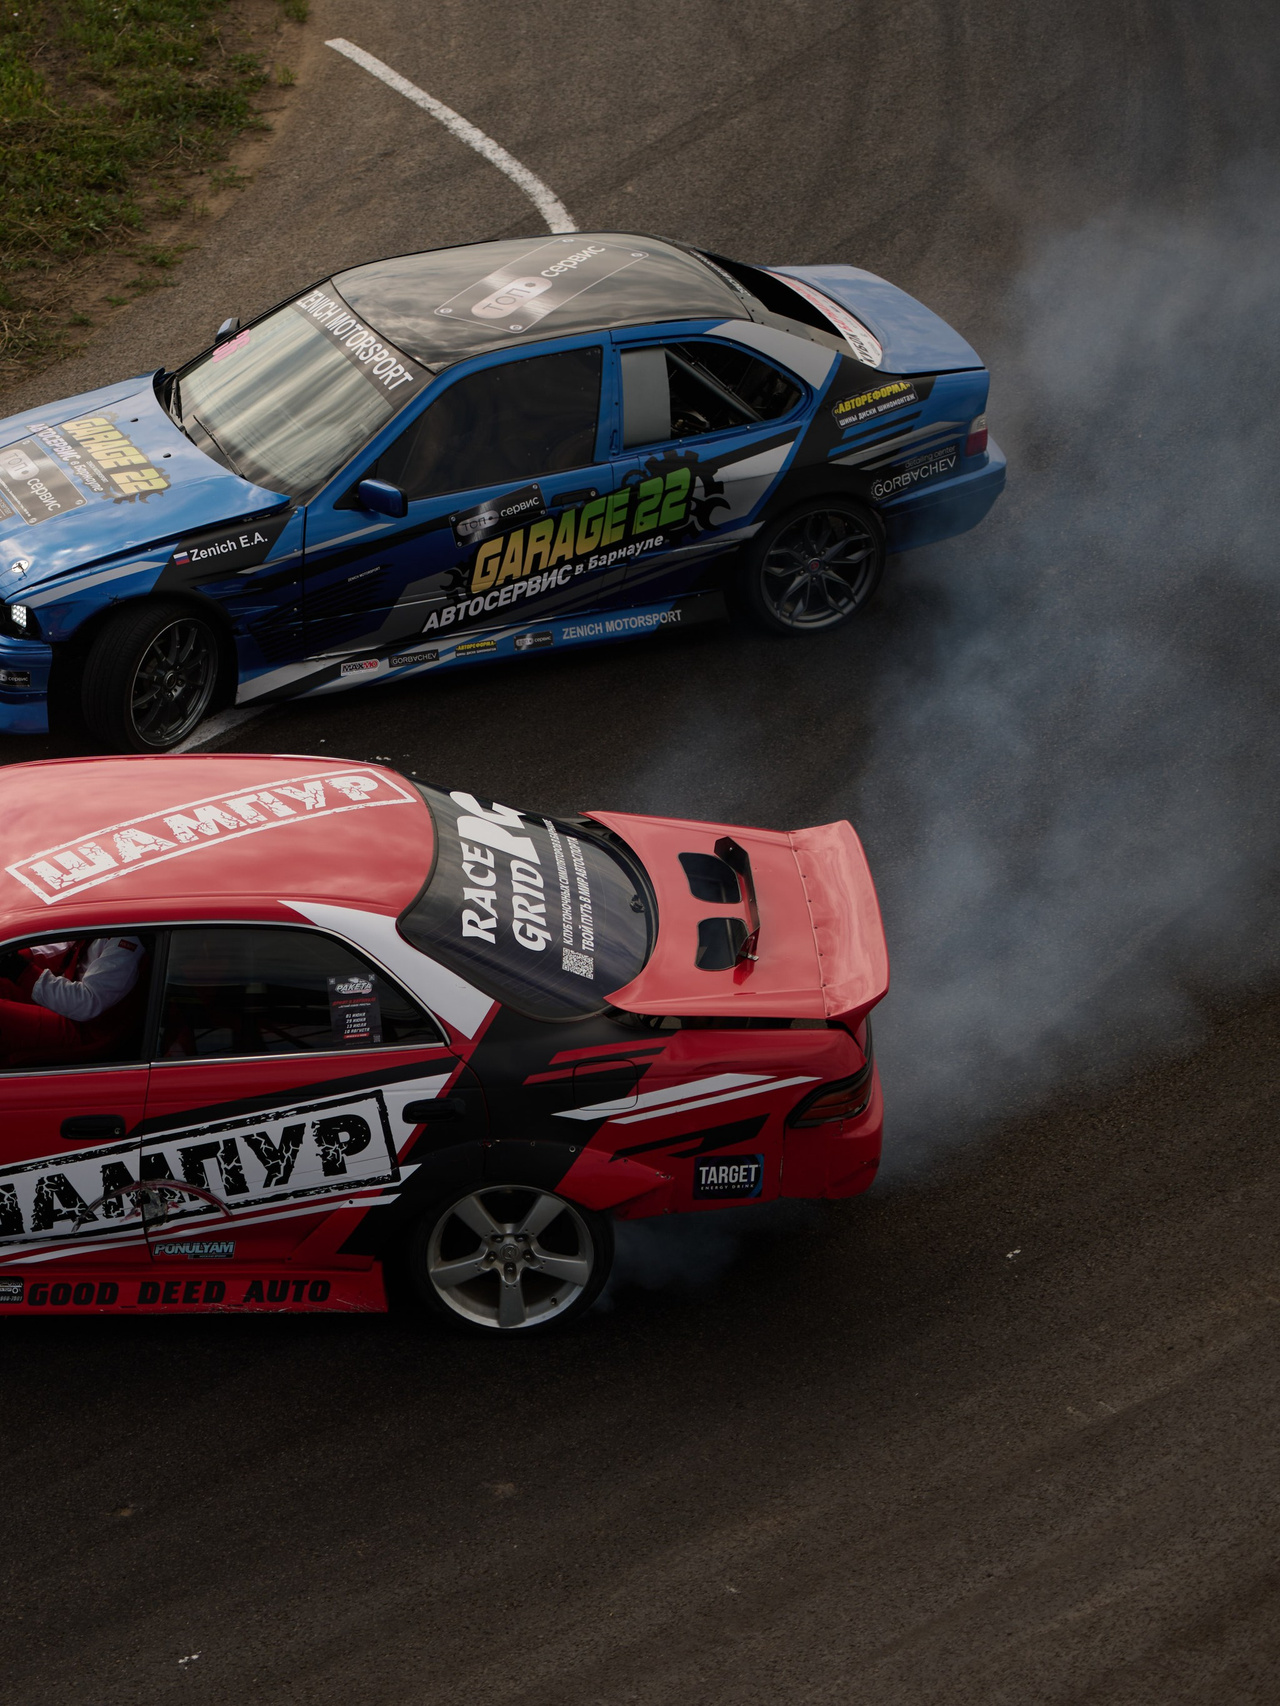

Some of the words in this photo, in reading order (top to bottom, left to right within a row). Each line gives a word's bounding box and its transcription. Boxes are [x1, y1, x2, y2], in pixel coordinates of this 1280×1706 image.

[482, 288, 531, 311] ТОП
[541, 246, 606, 278] сервис
[296, 290, 341, 326] ZENICH
[326, 313, 413, 390] MOTORSPORT
[26, 423, 81, 461] АВТОСЕРВИС
[74, 464, 104, 491] Барнауле
[60, 417, 148, 469] GARAGE
[110, 468, 169, 494] 22
[2, 452, 26, 472] ТОП
[27, 478, 61, 512] сервис
[461, 517, 488, 532] ТОП
[500, 497, 540, 518] сервис
[471, 487, 631, 594] GARAGE
[632, 467, 692, 535] 22
[190, 540, 237, 561] Zenich
[239, 532, 268, 548] E.A.
[422, 564, 573, 633] АВТОСЕРВИС
[574, 563, 586, 575] в
[588, 535, 664, 571] Барнауле
[562, 622, 604, 640] ZENICH
[606, 609, 682, 632] MOTORSPORT
[29, 776, 379, 890] ШАМПУР
[552, 843, 569, 885] СИМУЛЯТОРОВ
[566, 836, 587, 879] АВТОСПОРТА
[460, 842, 498, 944] RACE
[510, 860, 552, 951] GRID
[560, 884, 572, 924] ГОНОЧНЫХ
[577, 877, 590, 897] МИР
[579, 896, 591, 904] В
[563, 923, 573, 946] КЛУБ
[580, 904, 593, 926] ПУТЬ
[579, 925, 594, 952] ТВОЙ
[699, 1163, 759, 1184] TARGET
[154, 1241, 234, 1255] PONULYAM
